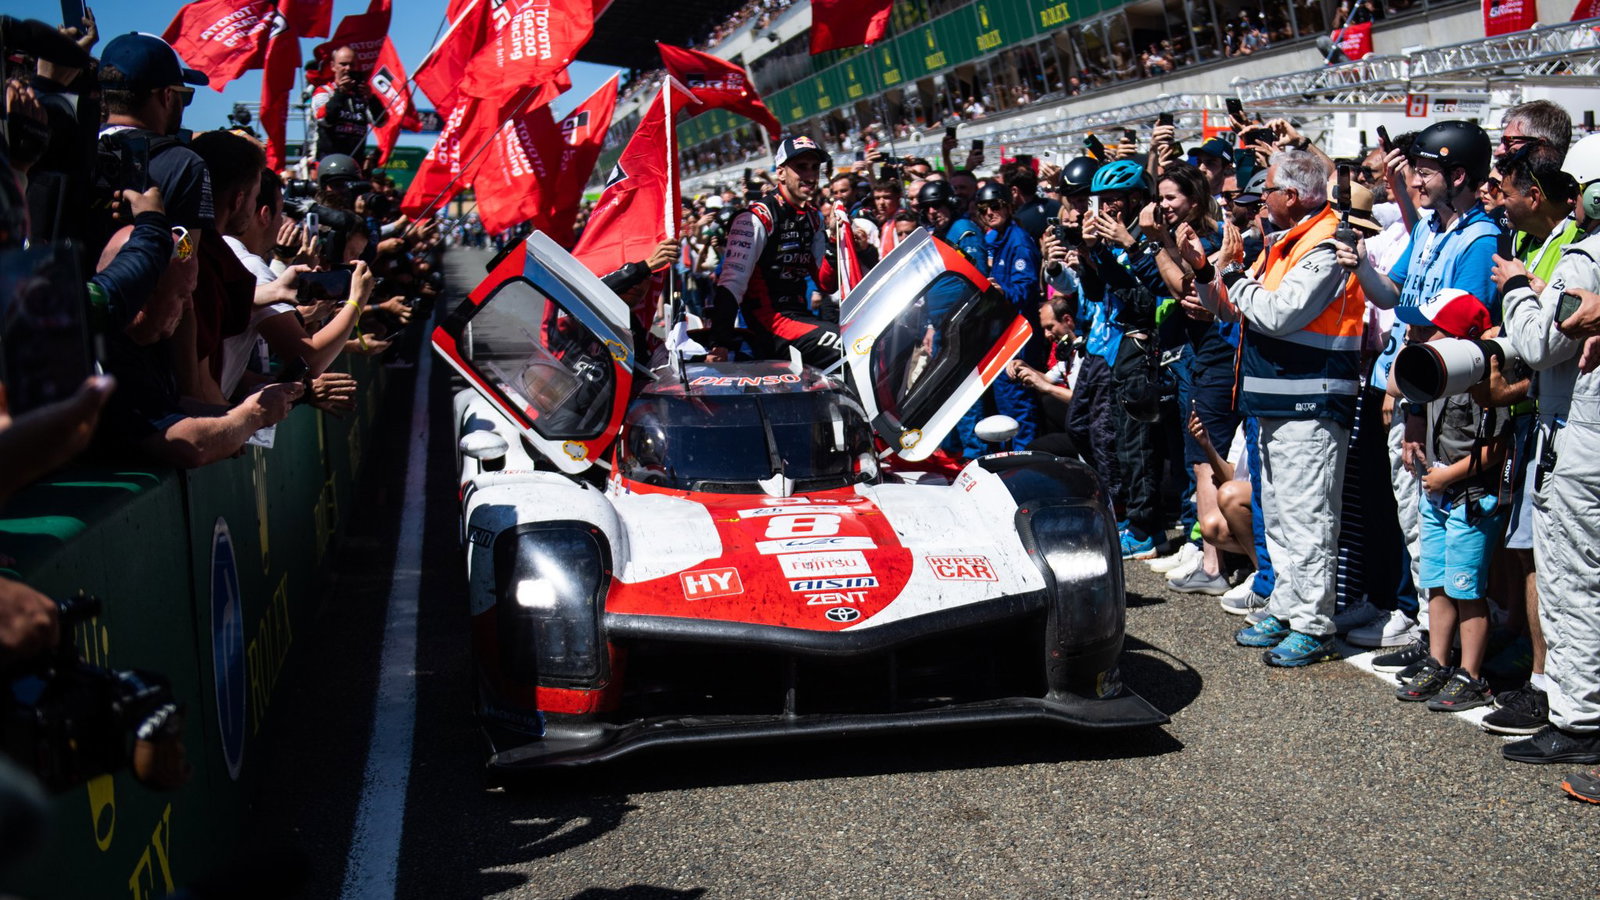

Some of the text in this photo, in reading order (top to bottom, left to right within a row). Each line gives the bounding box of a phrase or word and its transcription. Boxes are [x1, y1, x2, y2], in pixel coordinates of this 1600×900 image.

[1040, 3, 1070, 27] ROLEX
[509, 13, 523, 60] Racing
[523, 9, 537, 57] GAZOO
[536, 8, 552, 60] TOYOTA
[690, 373, 801, 387] DENSO
[1503, 459, 1513, 483] SONY
[765, 514, 841, 538] 8
[791, 557, 858, 571] FUJITSU
[931, 556, 985, 566] HYPER
[937, 564, 992, 579] CAR
[685, 571, 732, 595] HY
[794, 577, 875, 591] AISIN
[804, 590, 868, 605] ZENT
